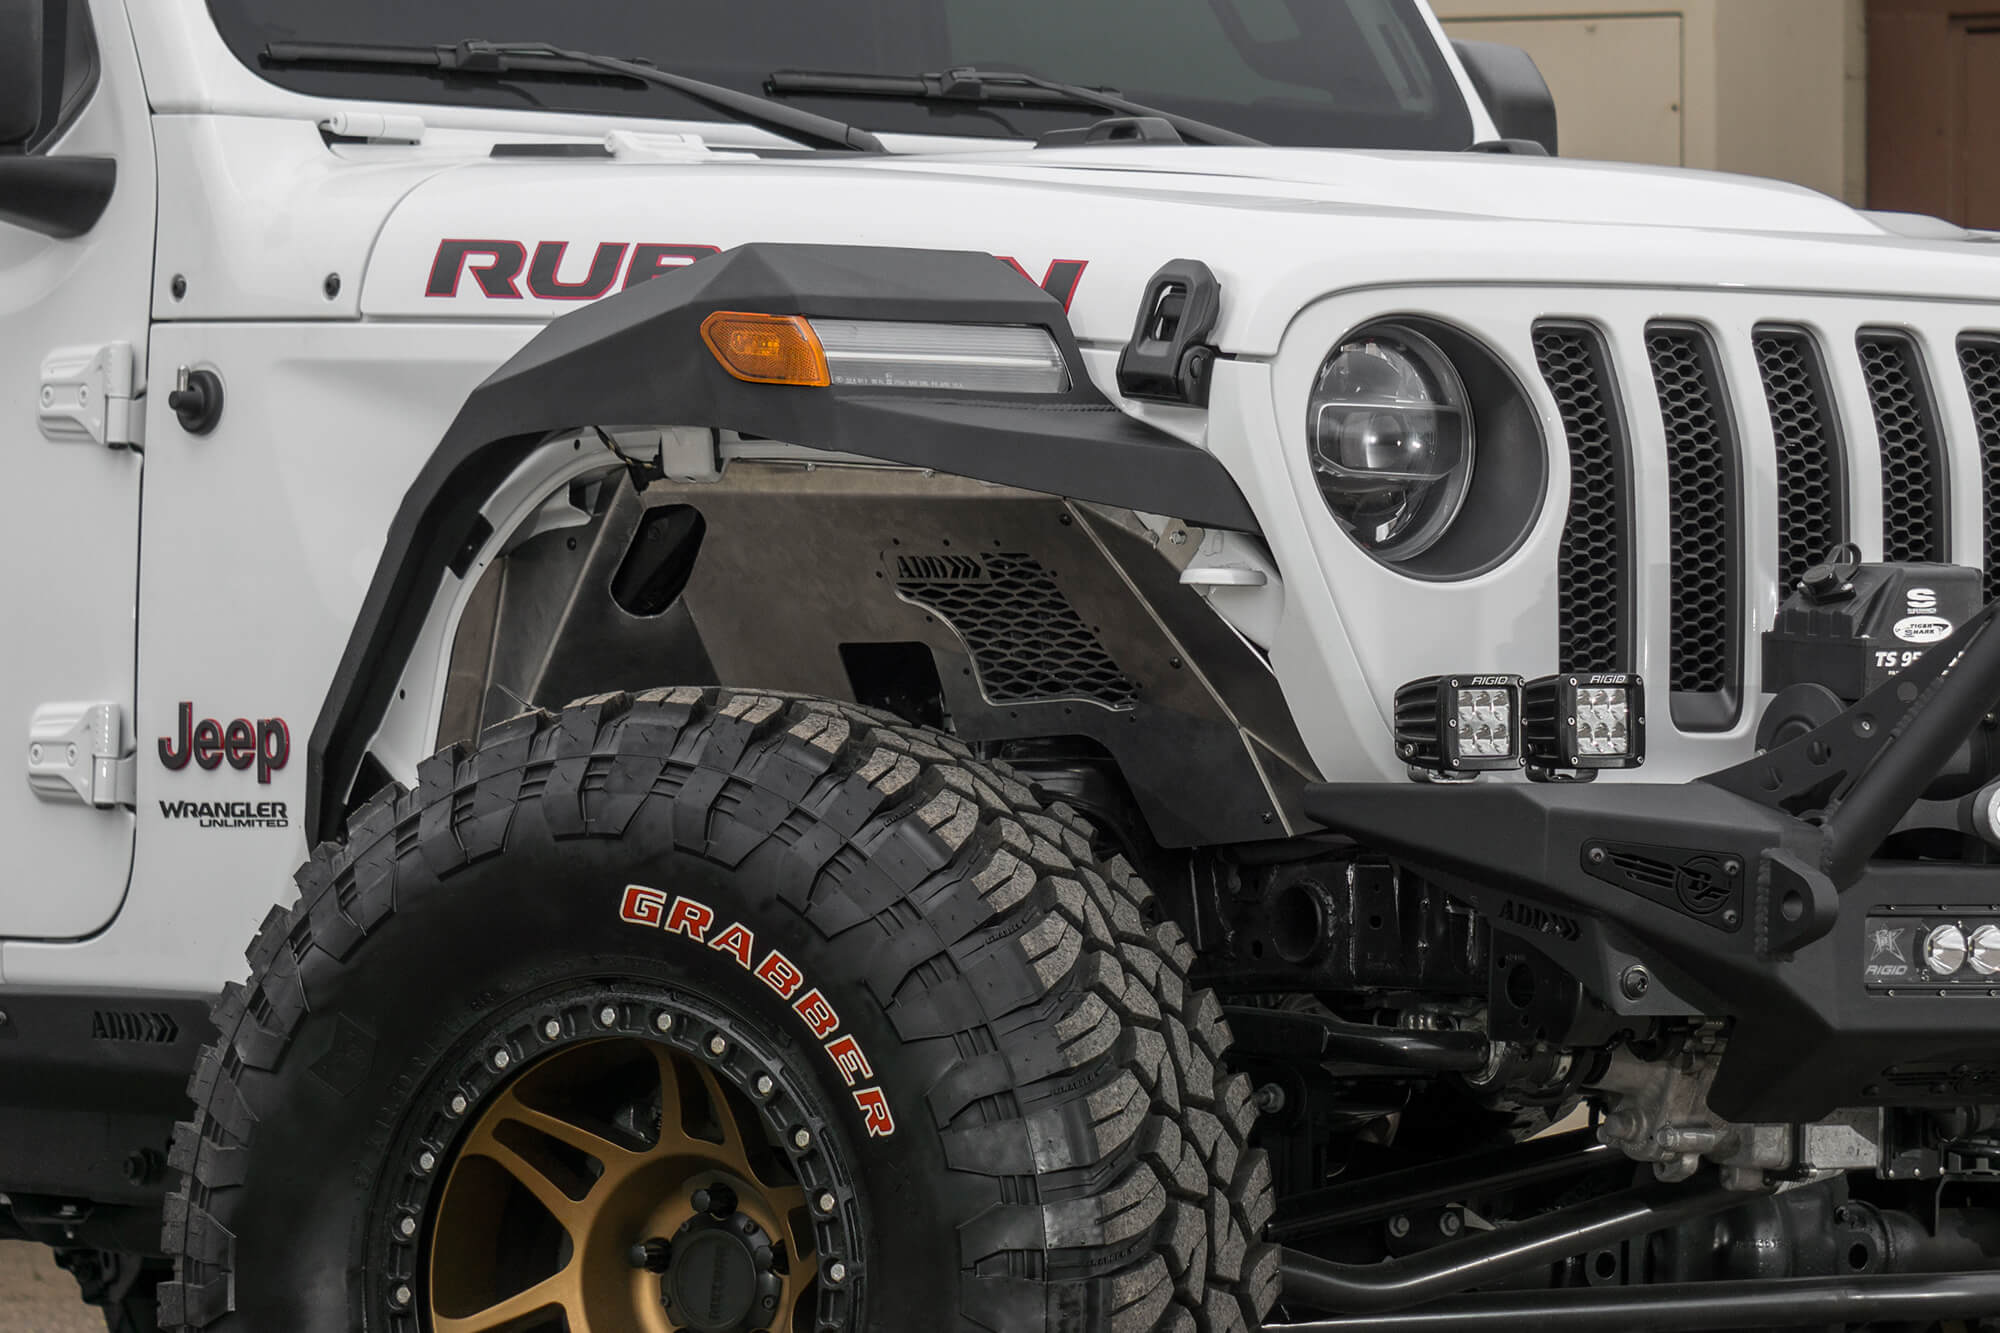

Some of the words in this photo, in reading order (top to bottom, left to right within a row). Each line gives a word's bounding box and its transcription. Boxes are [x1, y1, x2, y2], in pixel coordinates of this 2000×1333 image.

[1875, 651, 1898, 668] TS
[1471, 676, 1509, 686] RIGID
[1589, 674, 1626, 684] RIGID
[158, 701, 290, 785] Jeep
[159, 800, 288, 819] WRANGLER
[200, 819, 289, 828] UNLIMITED
[1864, 964, 1909, 976] RIGID
[618, 884, 896, 1138] GRABBER
